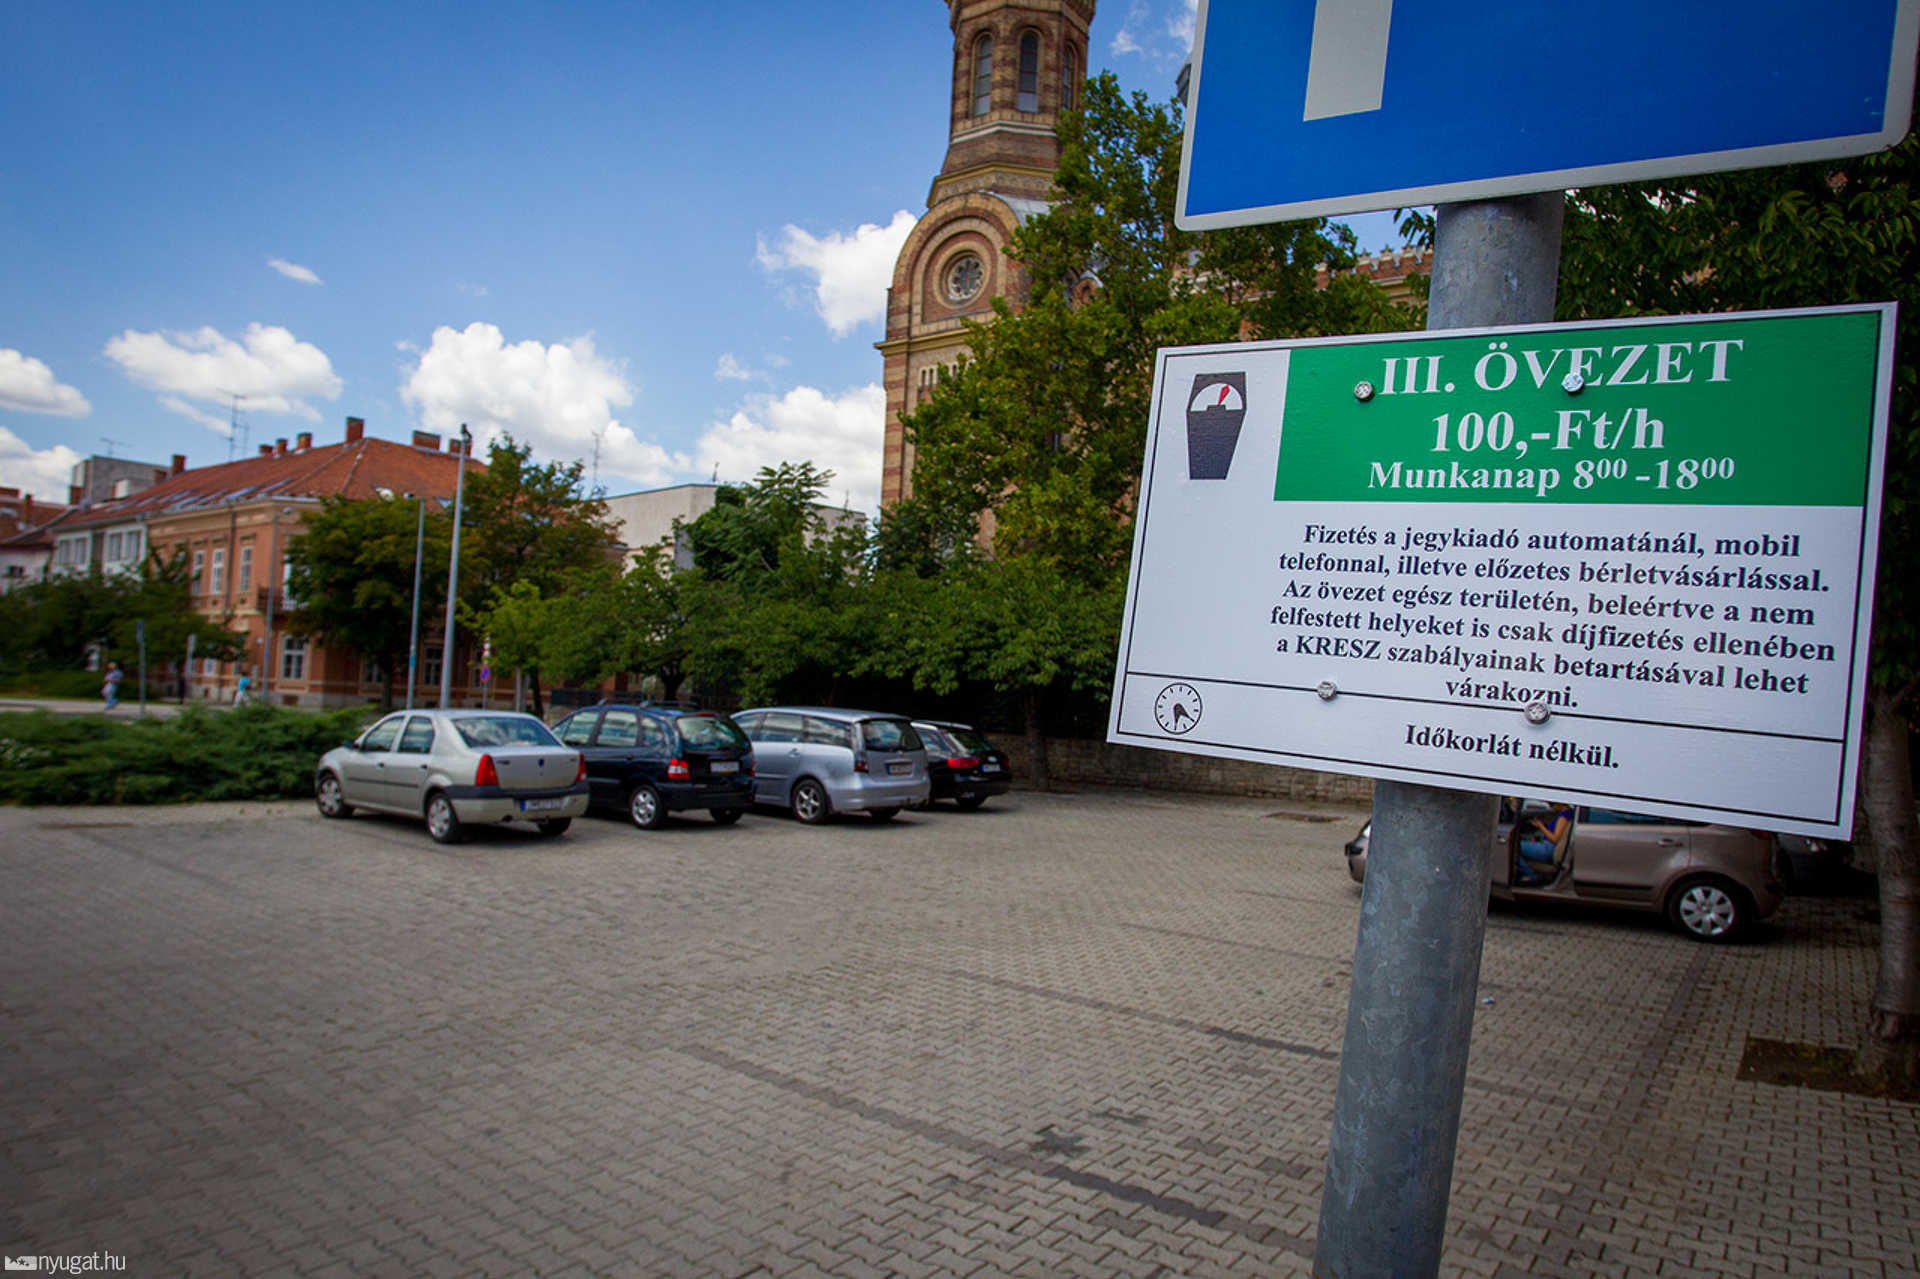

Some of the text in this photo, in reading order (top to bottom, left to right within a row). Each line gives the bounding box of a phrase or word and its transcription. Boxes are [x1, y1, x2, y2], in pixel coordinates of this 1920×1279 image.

[1378, 339, 1744, 395] III. ÖVEZET
[1430, 408, 1665, 459] 100,-Ft/h
[1368, 461, 1561, 497] Munkanap
[1303, 524, 1801, 559] Fizetés a jegykiadó automatánál, mobil
[1279, 552, 1830, 593] telefonnal, illetve előzetes bérletvásárlással.
[1282, 579, 1816, 626] Az övezet egész területén, beleértve a nem
[1270, 605, 1837, 662] felfestett helyeket is csak díjfizetés ellenében
[1276, 635, 1811, 695] a KRESZ szabályainak betartásával lehet
[1445, 676, 1578, 709] várakozni.
[1405, 724, 1620, 769] Időkorlát nélkül.
